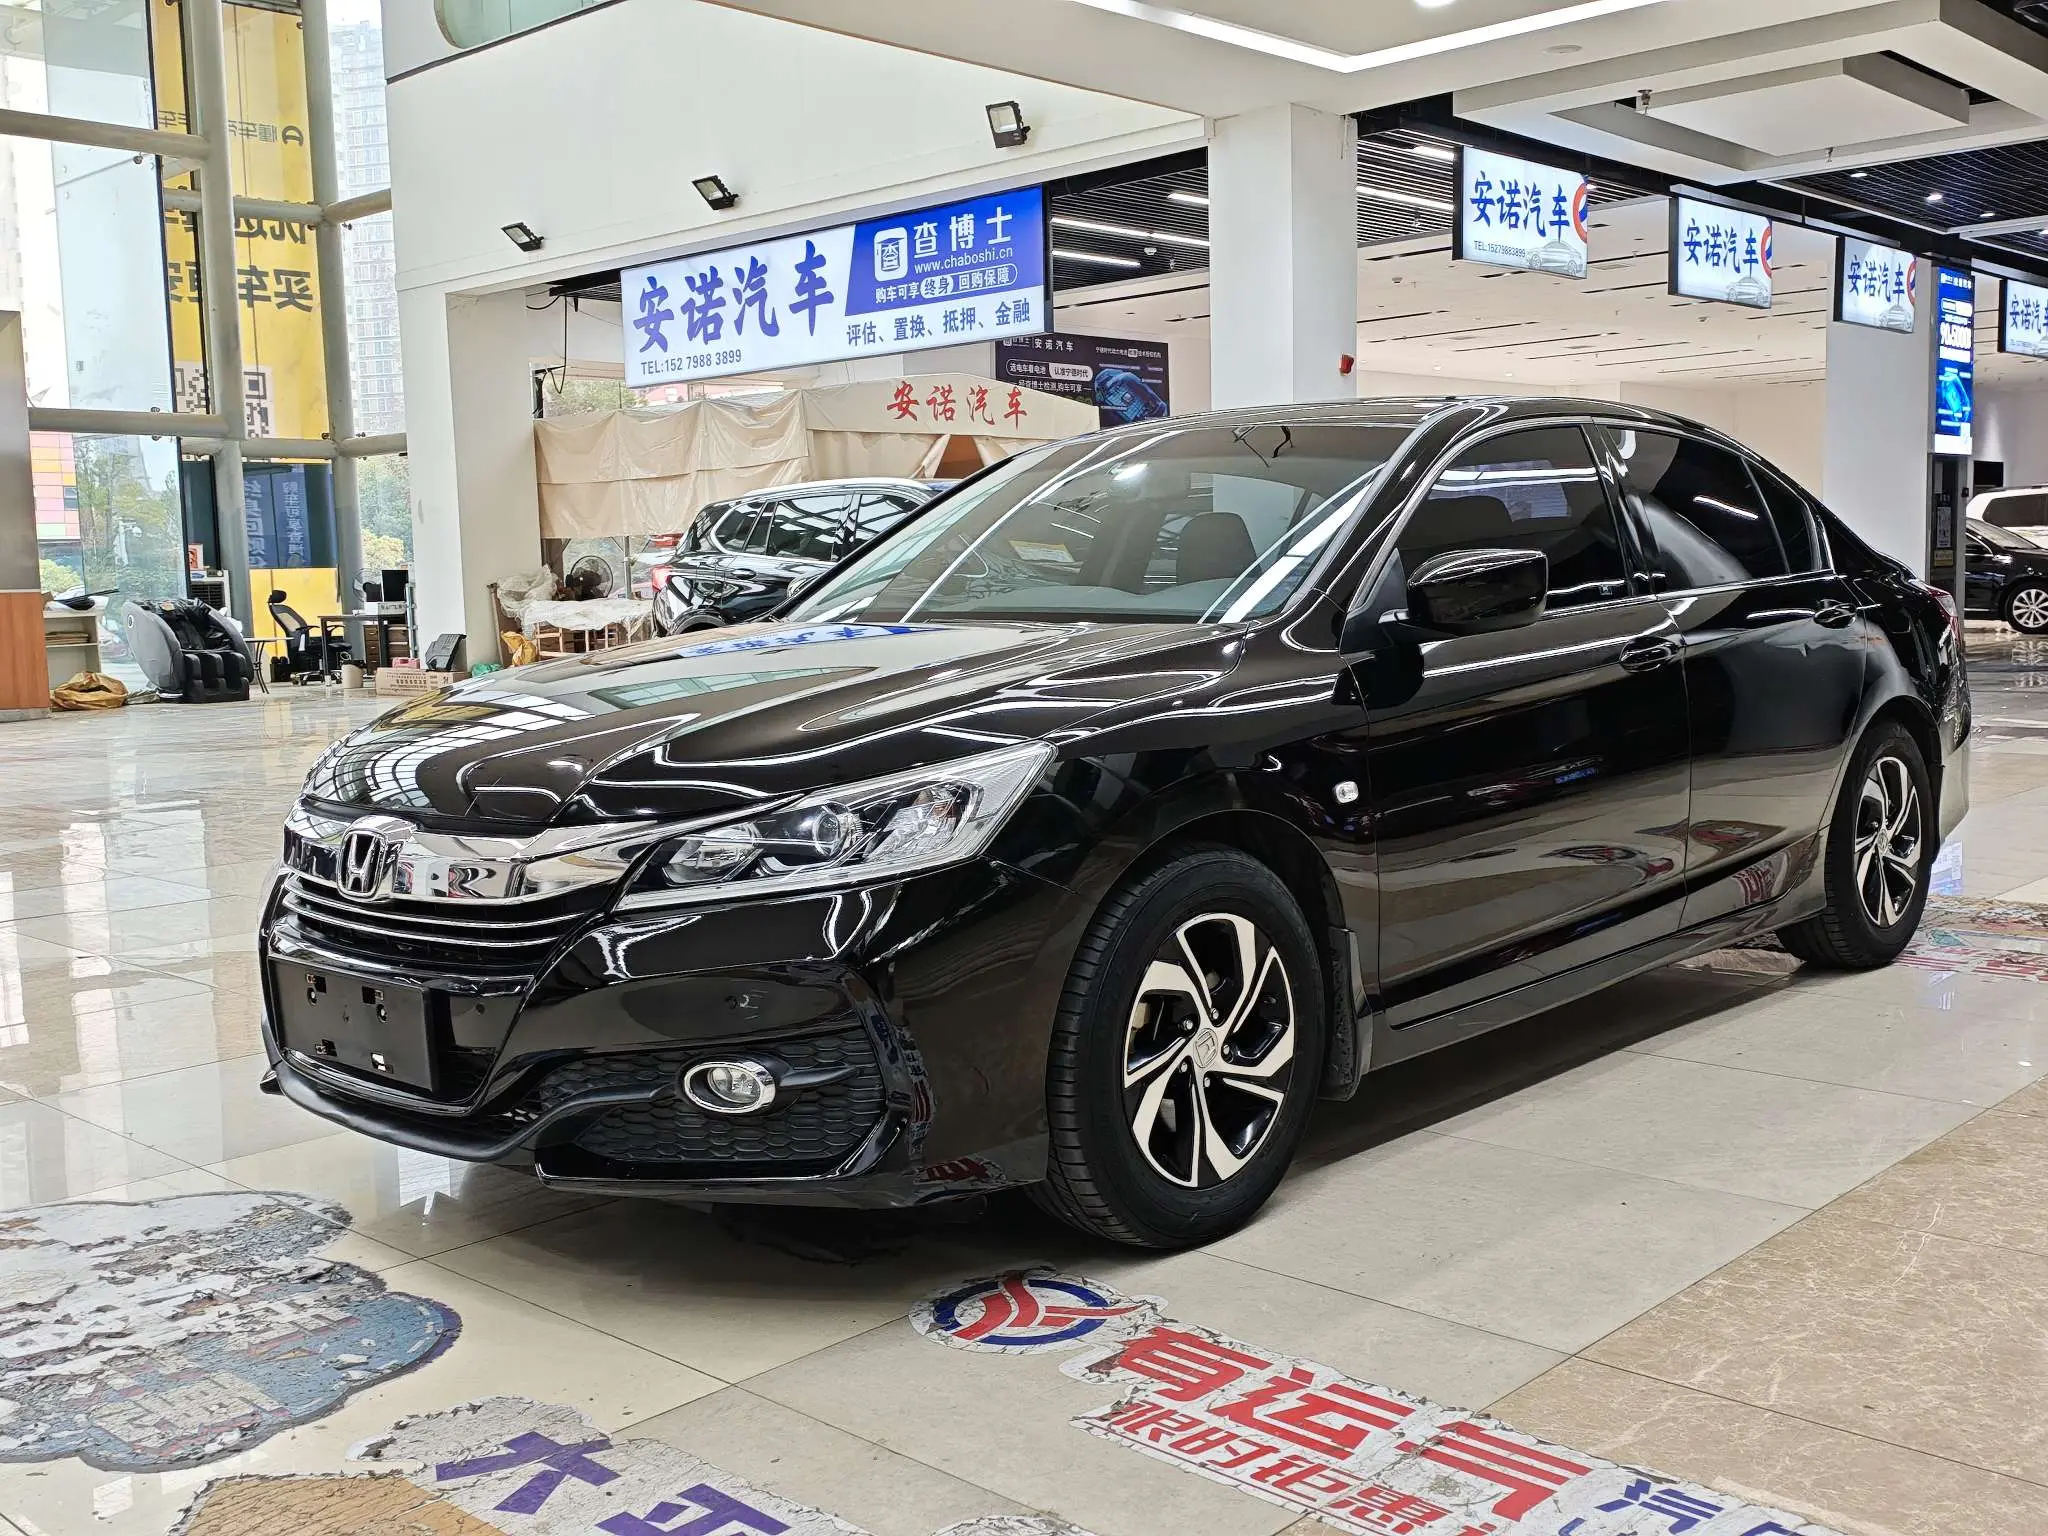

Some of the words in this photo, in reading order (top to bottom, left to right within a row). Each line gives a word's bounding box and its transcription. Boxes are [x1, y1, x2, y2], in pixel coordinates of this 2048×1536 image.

[1470, 170, 1570, 243] 安诺汽车
[914, 206, 1013, 258] 查博士
[1683, 217, 1759, 278] 安诺汽车
[875, 282, 920, 304] 购车可享
[924, 276, 951, 296] 终身
[958, 267, 1010, 291] 回购保障
[914, 247, 1013, 274] www.chaboshi.cn
[1847, 255, 1905, 305] 安诺汽车
[633, 239, 835, 353] 安诺汽车
[846, 297, 1031, 347] 评估、置换、抵押、金融
[1034, 338, 1074, 352] 安诺汽车
[641, 357, 683, 376] TEL:152
[686, 353, 713, 370] 7988
[715, 349, 742, 366] 3899
[887, 380, 1028, 429] 安诺汽车
